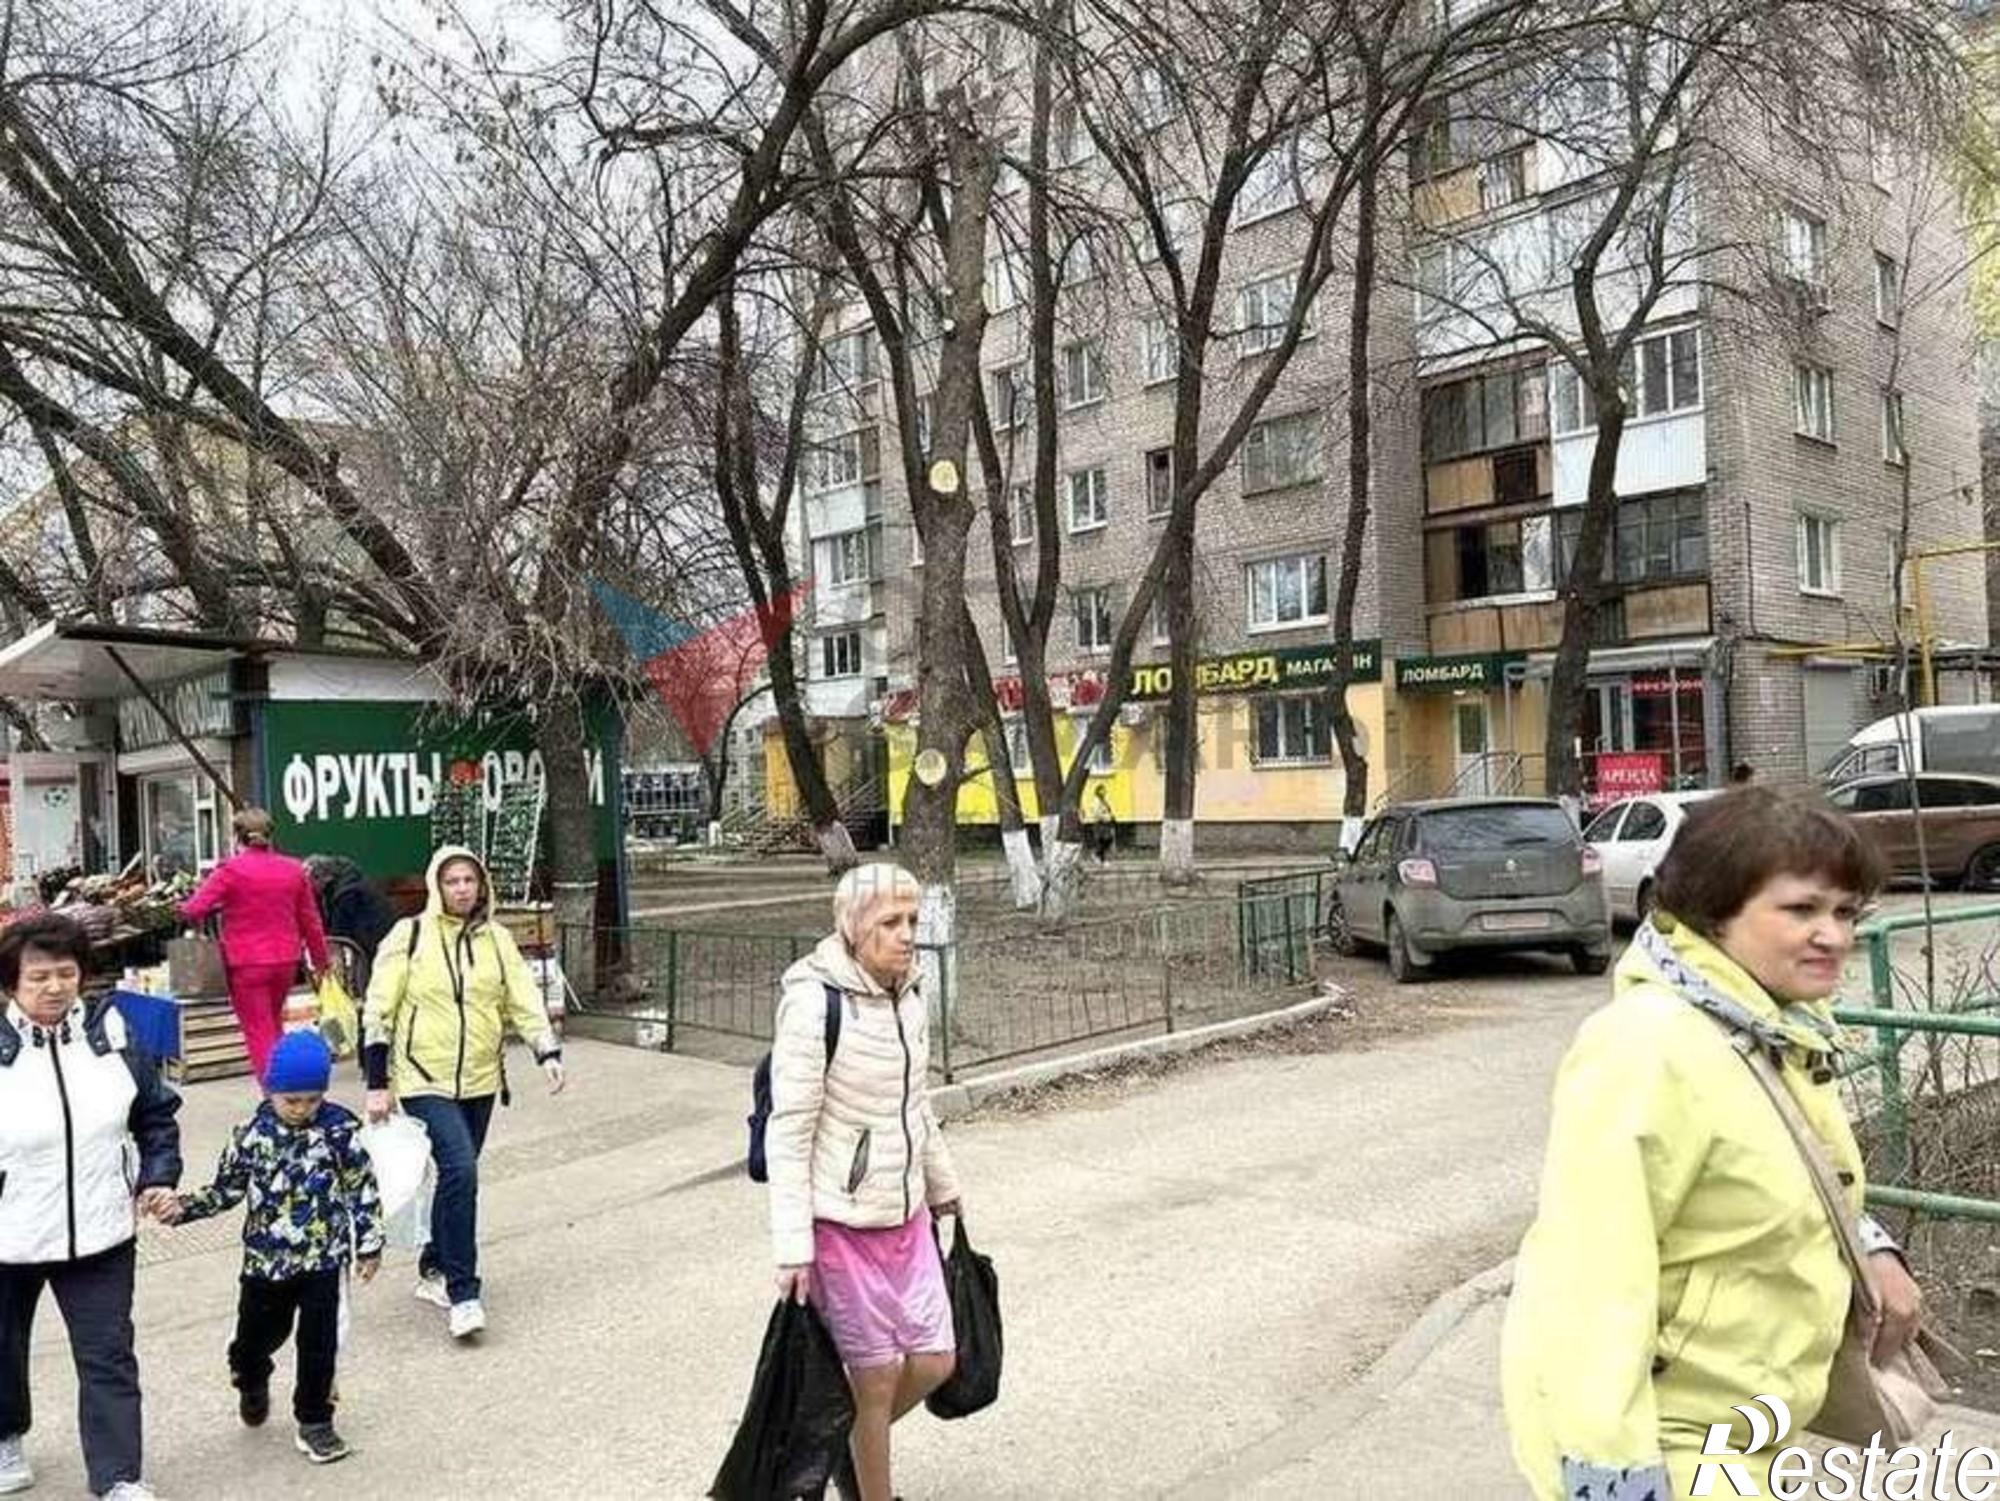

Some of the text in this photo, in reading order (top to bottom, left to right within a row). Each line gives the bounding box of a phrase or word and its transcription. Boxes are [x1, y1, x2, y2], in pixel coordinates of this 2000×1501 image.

[1130, 653, 1372, 695] ЛОБАРД МАГАН
[1402, 662, 1484, 684] ЛОМБАРД
[282, 749, 605, 824] ФРУКТЫ ОВОИ
[1602, 768, 1658, 785] АРЕНДА
